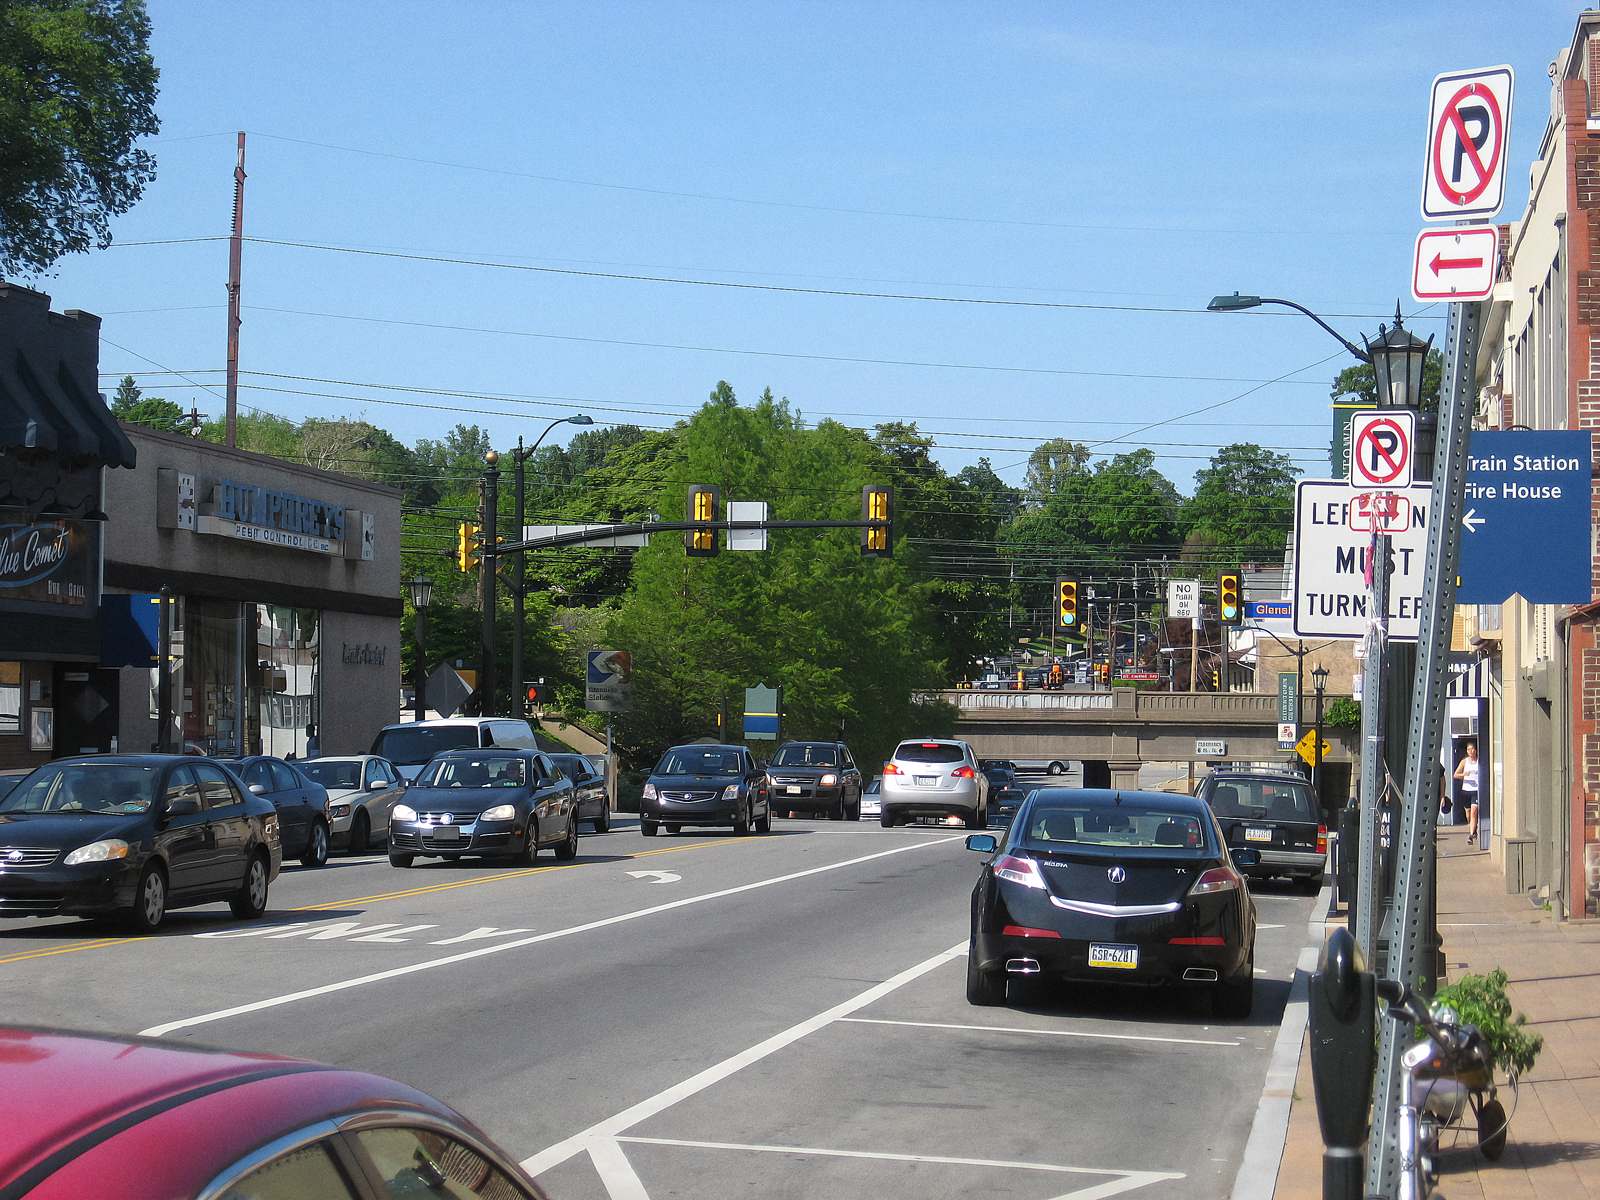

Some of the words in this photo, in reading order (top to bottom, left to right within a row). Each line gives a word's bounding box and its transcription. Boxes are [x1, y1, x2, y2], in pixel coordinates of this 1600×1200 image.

[1466, 455, 1507, 471] Train
[1513, 455, 1579, 472] Station
[1464, 483, 1497, 499] Fire
[1503, 483, 1562, 499] House
[1312, 502, 1349, 526] LEF
[0, 537, 20, 576] lue
[24, 527, 70, 571] Comet
[1176, 584, 1191, 593] NO
[1306, 593, 1366, 617] TURN
[1388, 596, 1422, 619] EF
